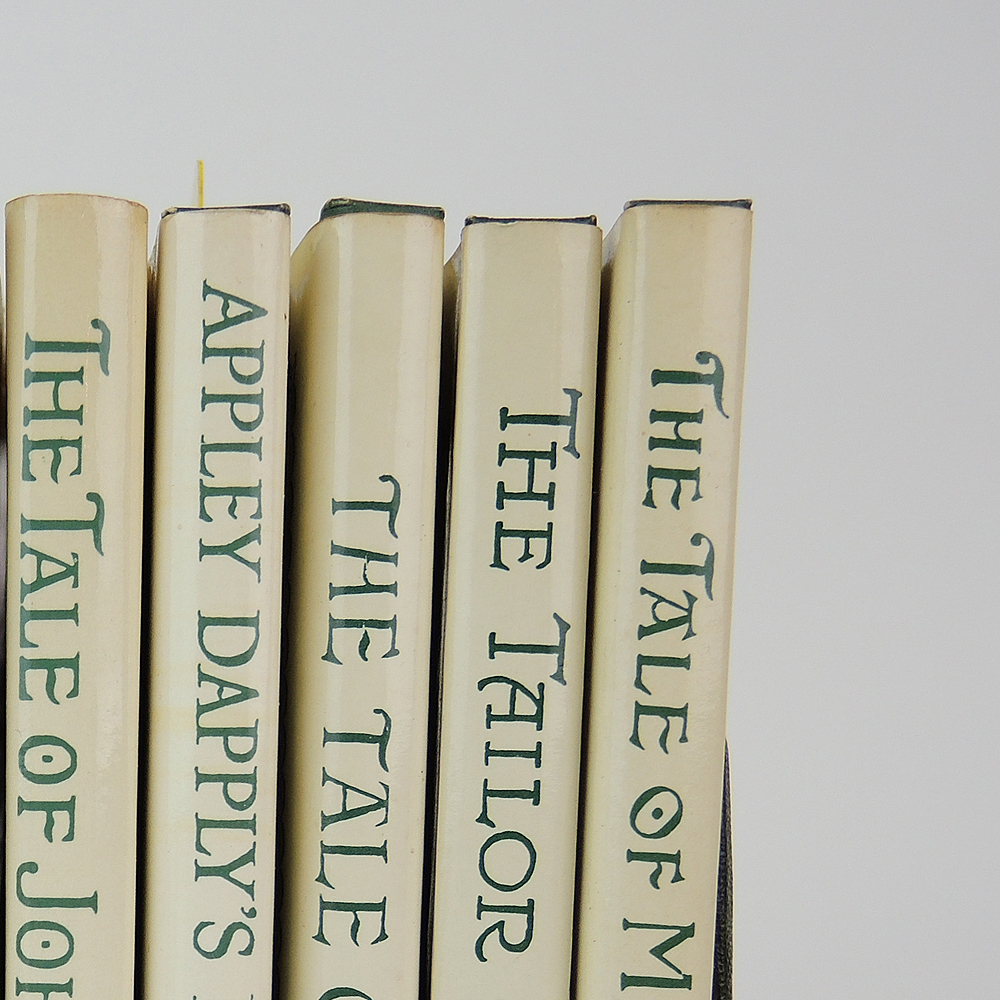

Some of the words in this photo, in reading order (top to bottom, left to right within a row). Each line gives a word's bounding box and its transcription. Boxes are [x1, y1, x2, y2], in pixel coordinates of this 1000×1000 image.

[22, 318, 110, 484] THE
[199, 279, 268, 581] APPLEY
[489, 388, 580, 571] THE
[642, 351, 727, 510] THE
[19, 492, 105, 705] TALE
[321, 475, 401, 665] THE
[629, 533, 714, 754] TALE
[17, 735, 77, 843] OF
[312, 709, 391, 947] TALE
[475, 613, 570, 962] TAILOR
[626, 786, 685, 889] OF
